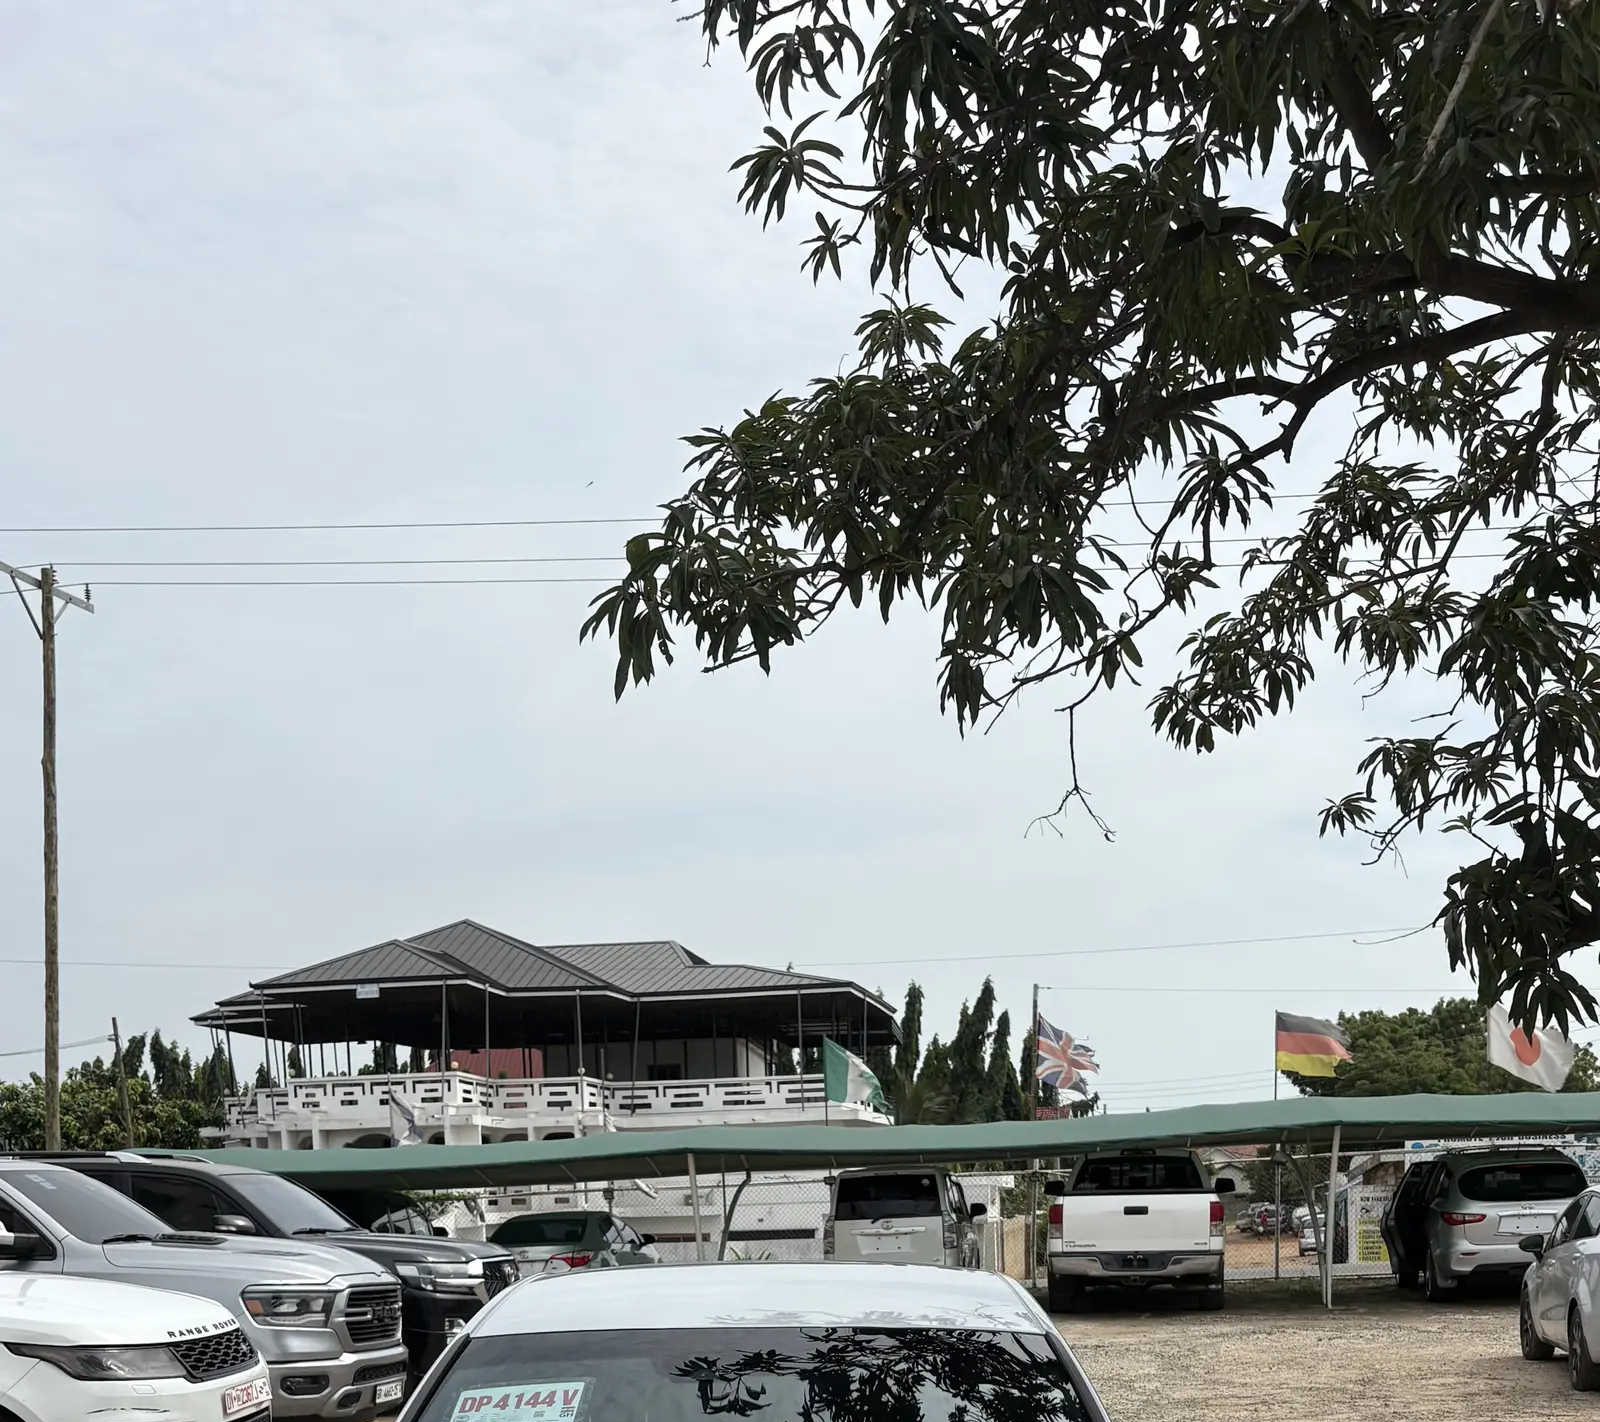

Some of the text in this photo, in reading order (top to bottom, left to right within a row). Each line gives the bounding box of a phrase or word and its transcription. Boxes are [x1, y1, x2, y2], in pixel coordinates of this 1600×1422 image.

[166, 1318, 237, 1338] RANGE ROVER
[458, 1389, 580, 1414] DP 4144 V
